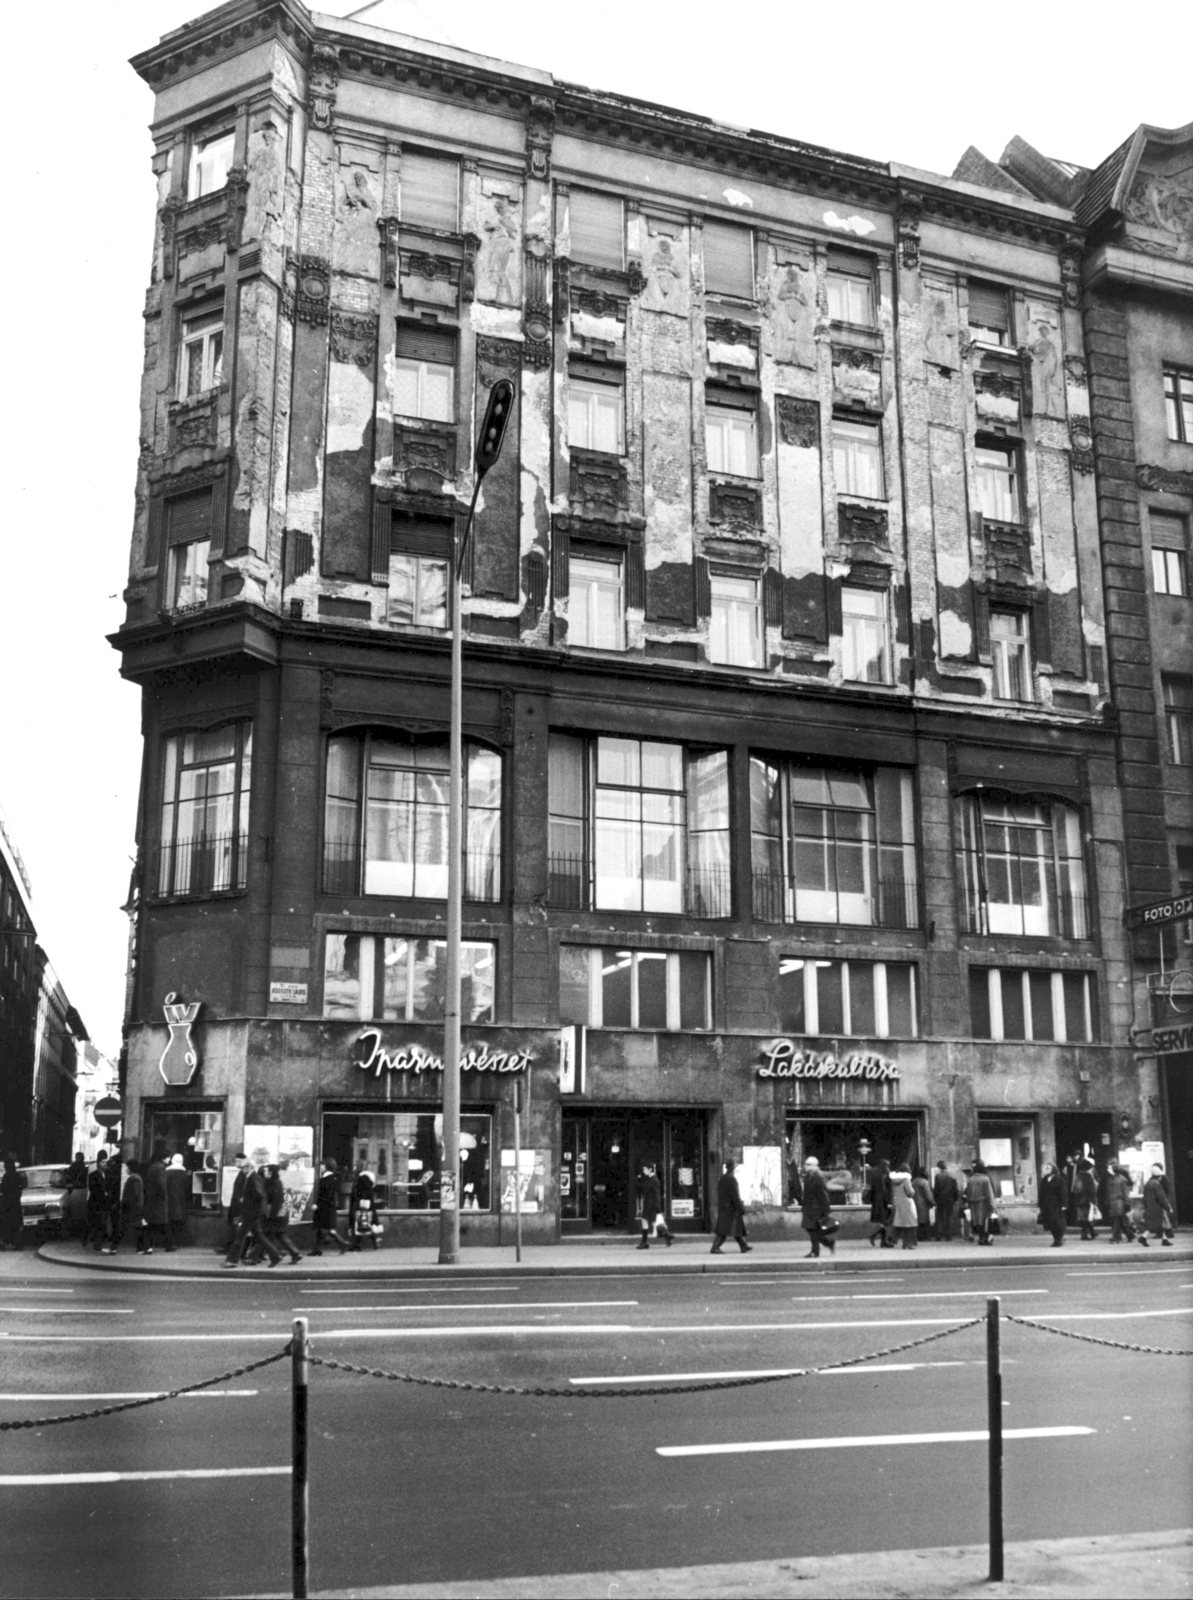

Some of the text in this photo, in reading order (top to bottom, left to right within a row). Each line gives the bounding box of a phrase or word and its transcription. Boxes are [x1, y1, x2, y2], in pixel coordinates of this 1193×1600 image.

[1144, 899, 1193, 921] FOTO OP
[1152, 1027, 1193, 1052] SERVI
[359, 1030, 534, 1077] Iparmvészet
